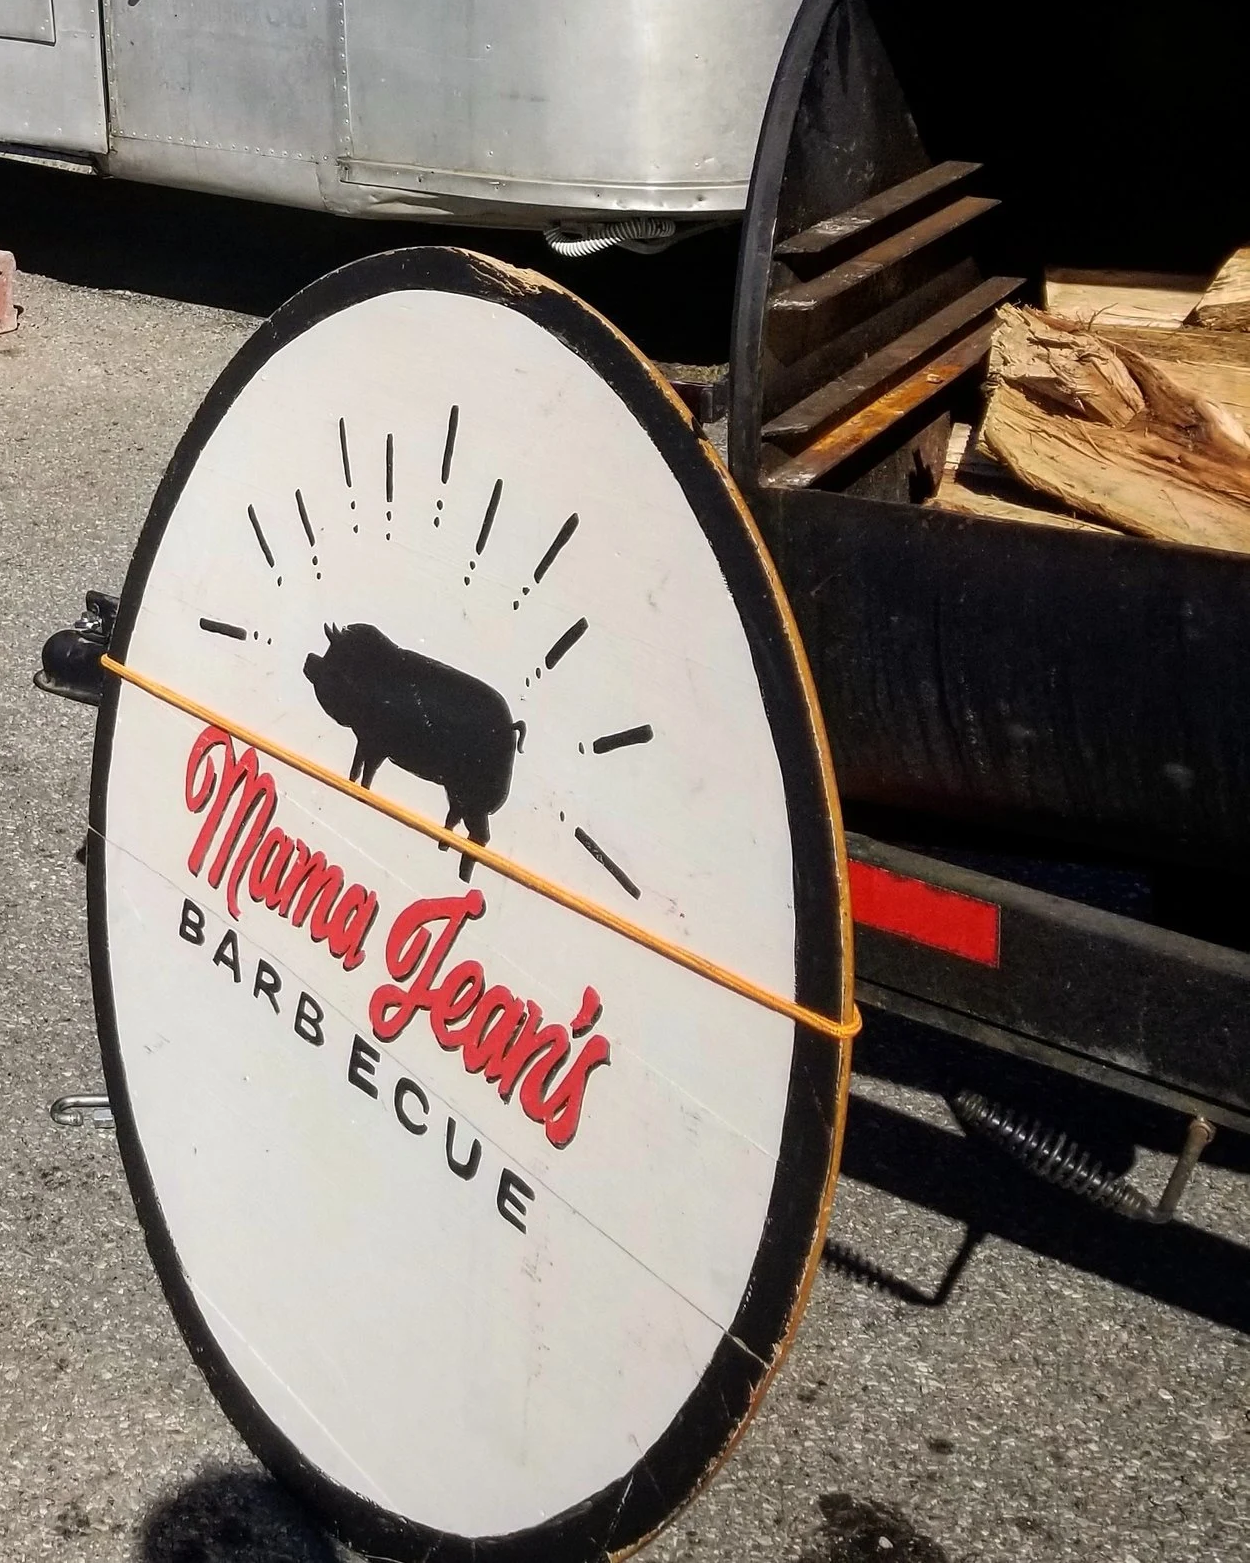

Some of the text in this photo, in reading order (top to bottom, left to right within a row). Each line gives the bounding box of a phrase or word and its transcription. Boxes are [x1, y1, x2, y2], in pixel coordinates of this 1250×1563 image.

[178, 897, 537, 1236] BARBECUE
[183, 724, 615, 1152] Mama Jean's
